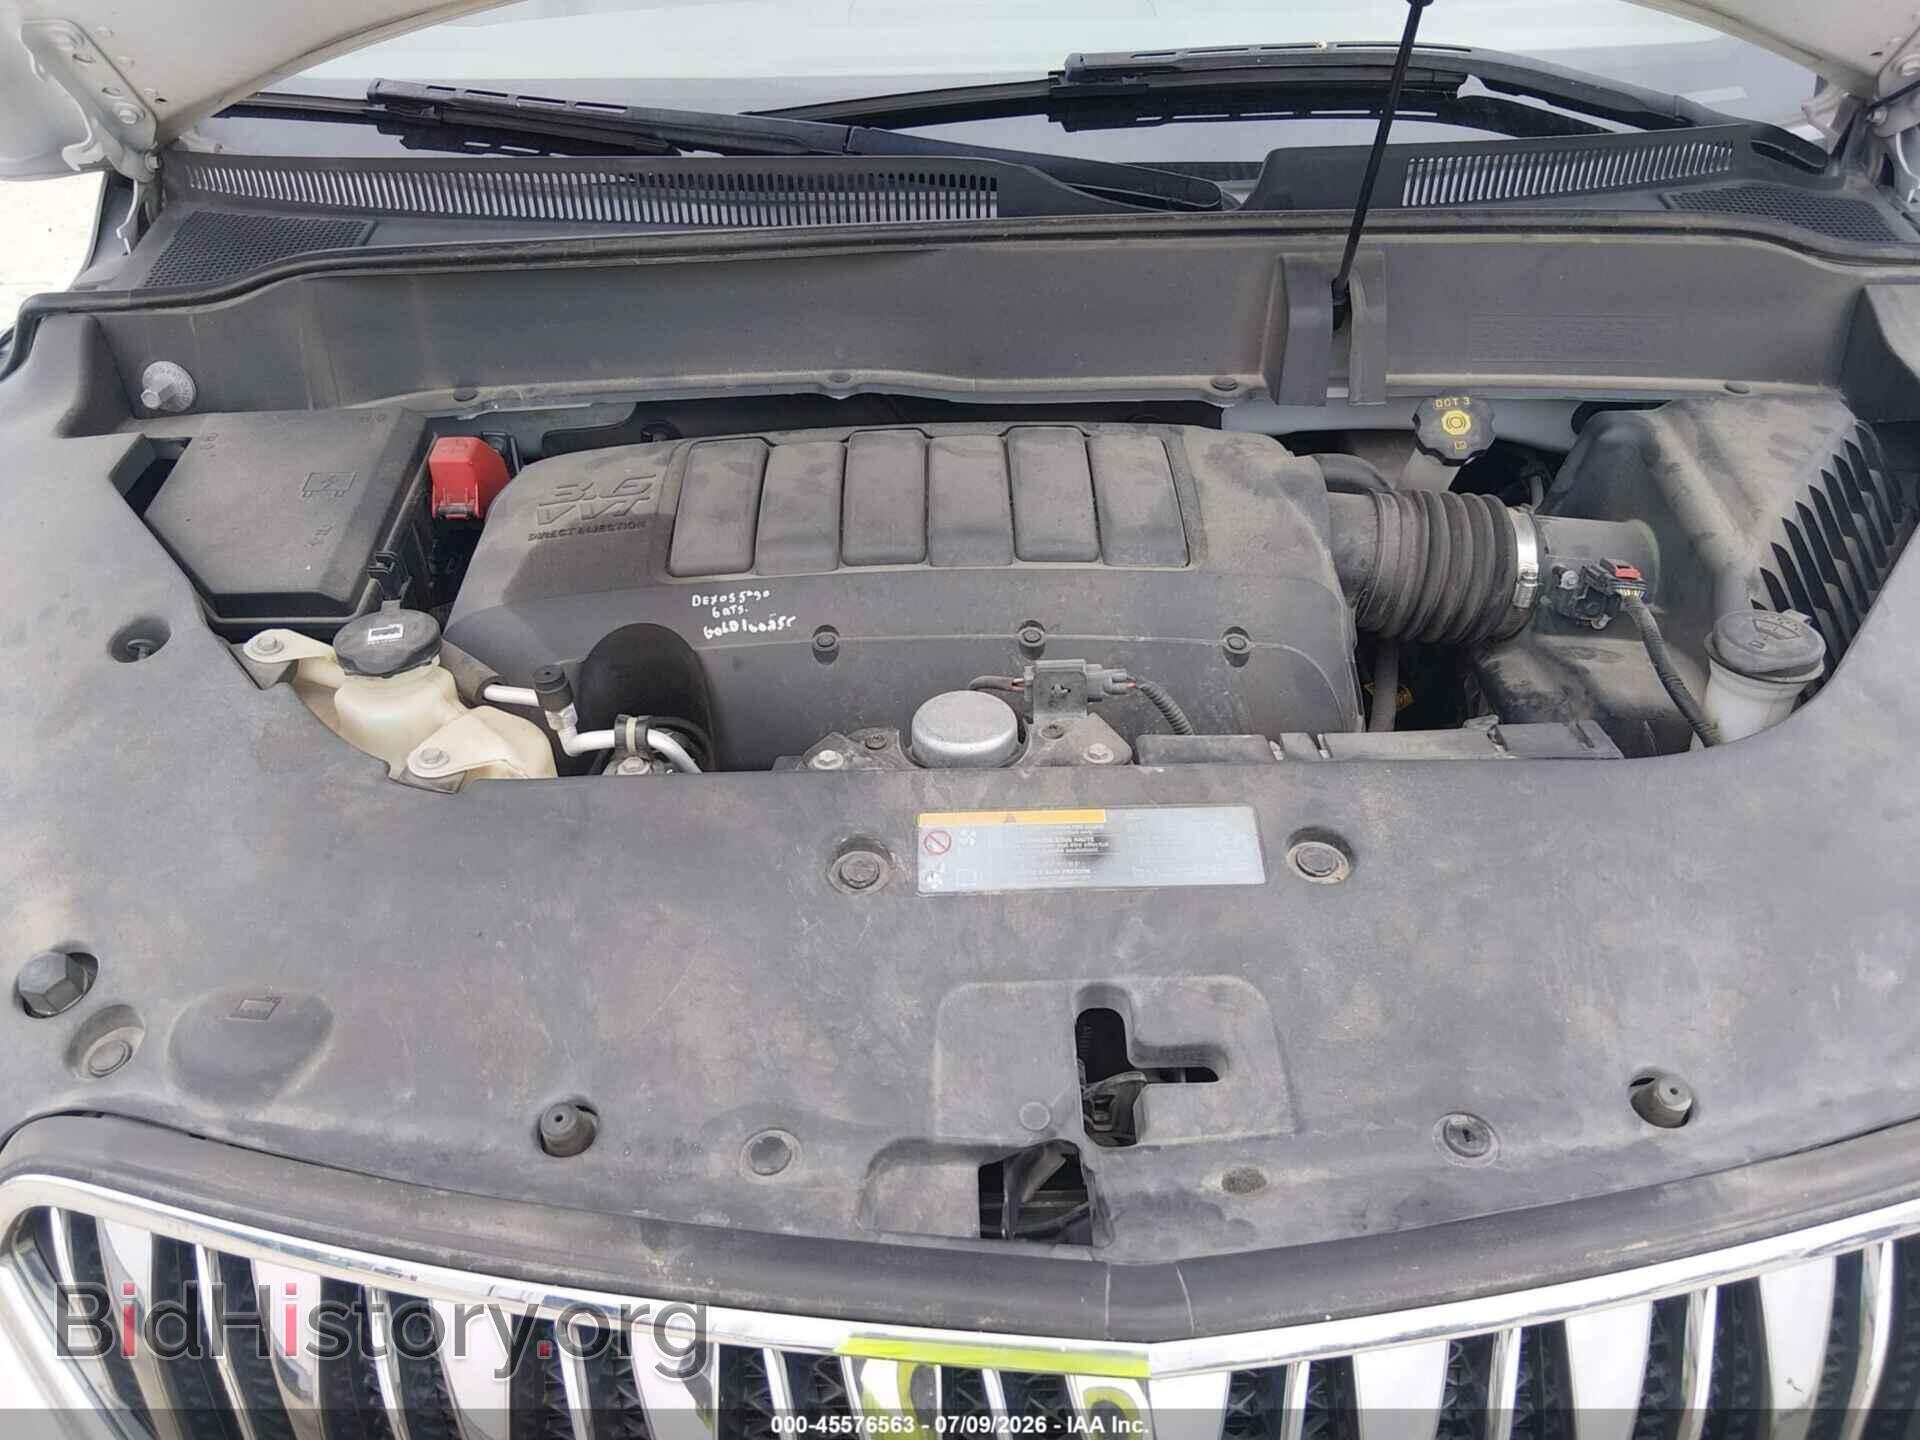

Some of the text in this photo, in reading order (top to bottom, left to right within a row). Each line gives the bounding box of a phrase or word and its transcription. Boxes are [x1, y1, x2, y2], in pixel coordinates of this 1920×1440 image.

[1435, 396, 1471, 408] DOT 3
[527, 526, 577, 542] DIRECT
